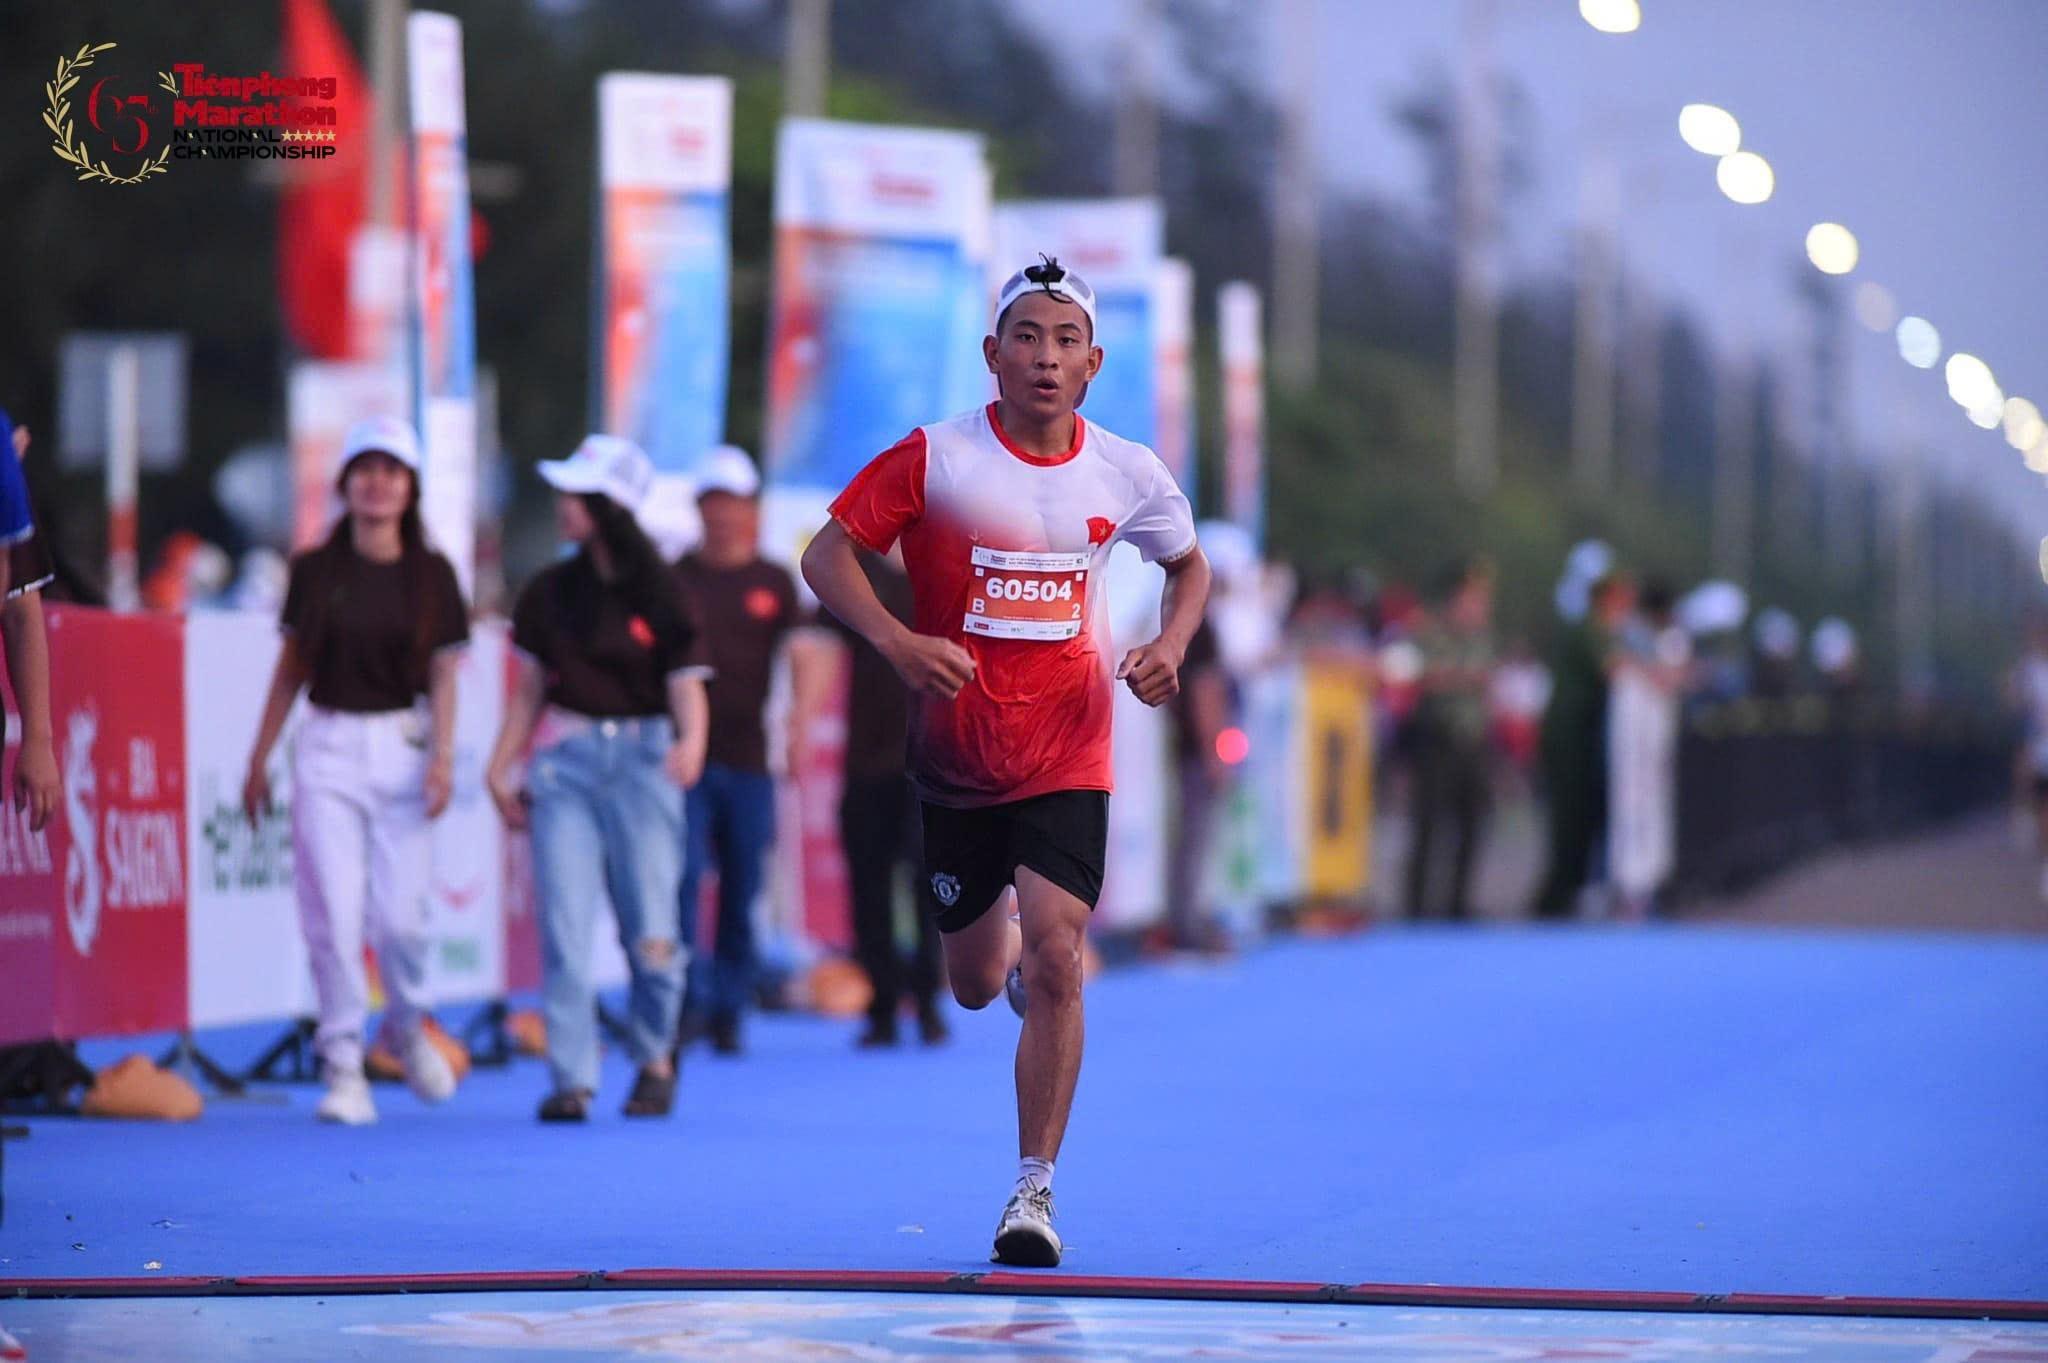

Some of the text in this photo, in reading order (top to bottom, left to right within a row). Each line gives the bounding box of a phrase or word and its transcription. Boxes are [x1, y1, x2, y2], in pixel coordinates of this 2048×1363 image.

[986, 577, 1072, 602] 60504
[972, 598, 985, 613] B
[1071, 603, 1081, 619] 2
